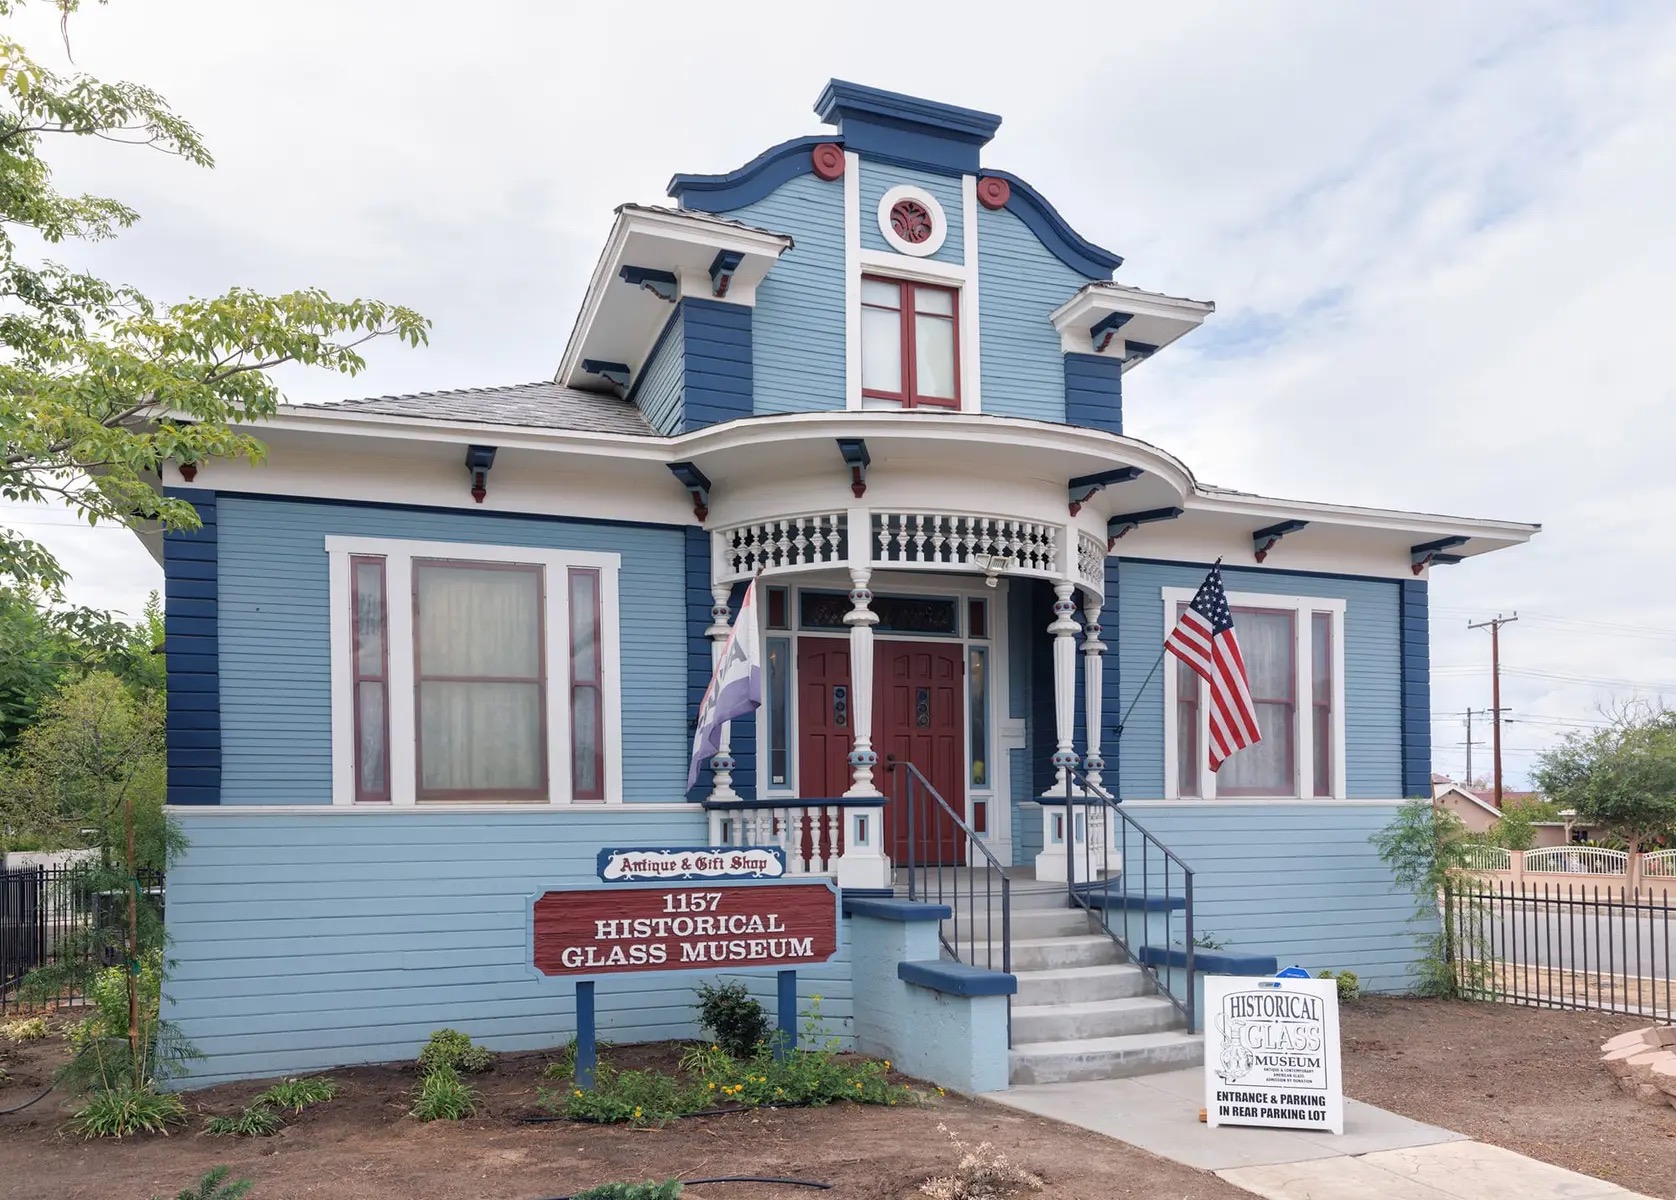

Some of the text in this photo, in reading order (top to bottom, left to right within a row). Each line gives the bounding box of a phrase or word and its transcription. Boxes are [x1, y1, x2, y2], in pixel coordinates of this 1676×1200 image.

[620, 855, 768, 874] Antique & Gift Shop
[662, 892, 723, 913] 1157
[594, 913, 785, 940] HISTORICAL
[561, 937, 814, 968] GLASS MUSEUM
[1230, 995, 1320, 1022] HISTORICAL
[1247, 1023, 1321, 1051] GLASS
[1254, 1055, 1321, 1068] MUSEUM
[1216, 1091, 1326, 1107] ENTRANCE & PARKING
[1219, 1105, 1327, 1121] IN REAR PARKING LOT
